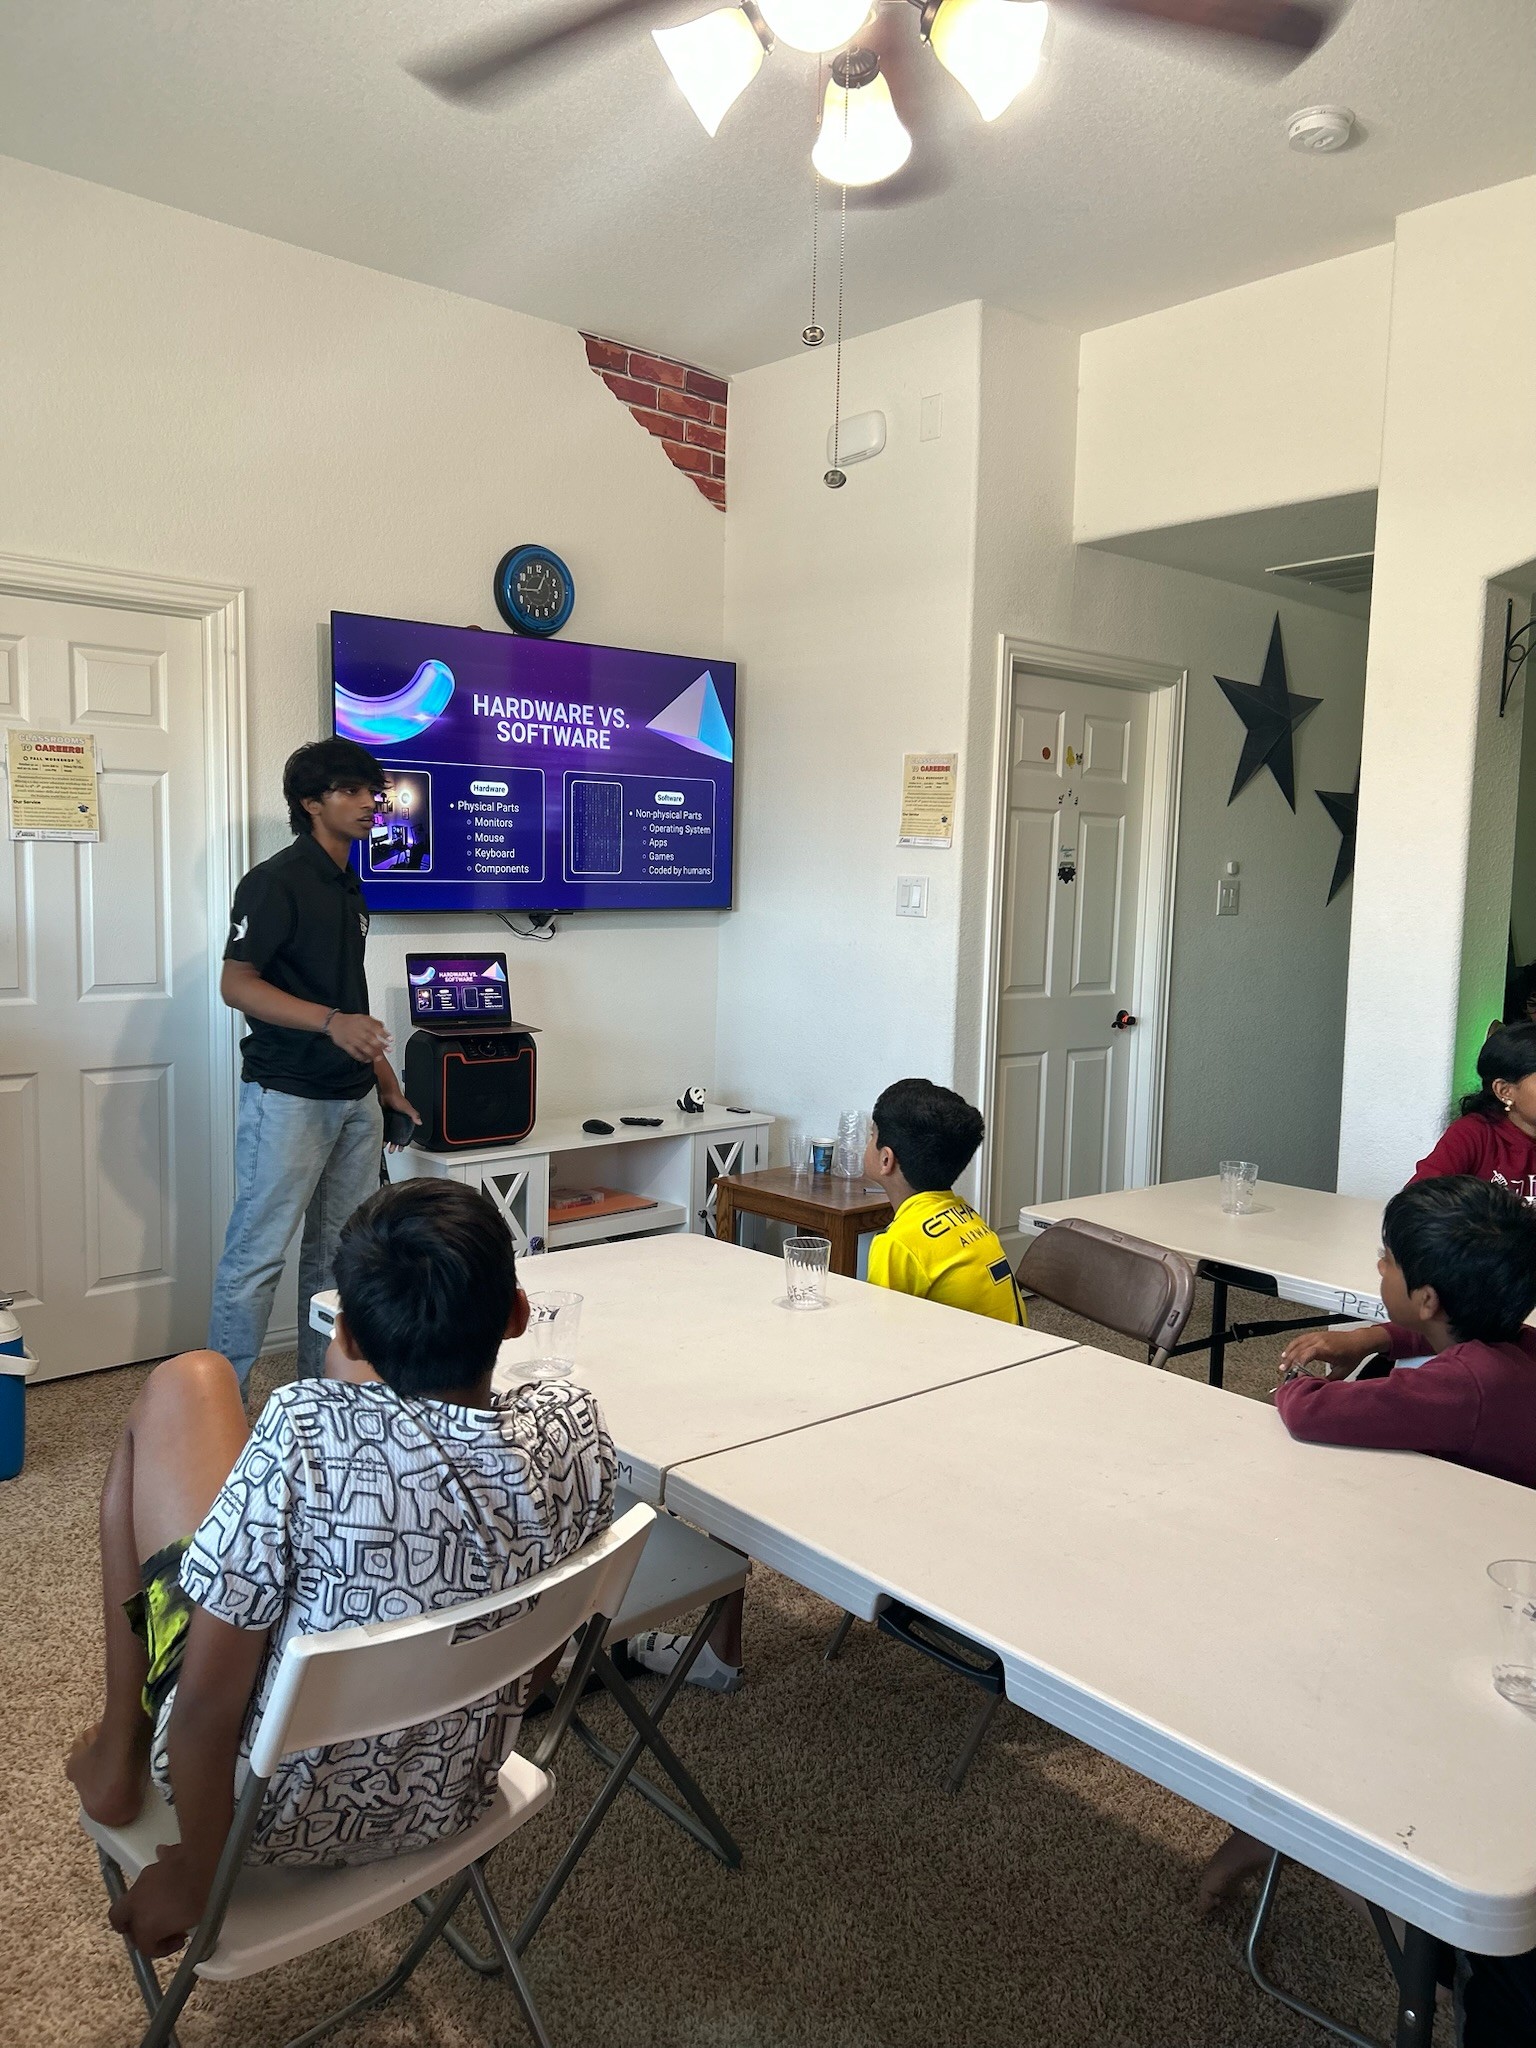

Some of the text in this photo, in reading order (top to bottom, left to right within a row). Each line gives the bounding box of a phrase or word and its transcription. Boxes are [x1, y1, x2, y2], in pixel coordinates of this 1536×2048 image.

[527, 566, 533, 574] 11
[536, 565, 542, 573] 12
[546, 570, 550, 578] 1
[552, 579, 556, 587] 2
[520, 595, 524, 604] 8
[554, 591, 559, 599] 3
[527, 605, 531, 613] 7
[535, 609, 539, 617] 6
[544, 608, 549, 616] 5
[473, 694, 630, 729] HARDWARE VS.
[19, 734, 85, 744] CLASSROOMS
[496, 720, 611, 750] SOFTWARE
[35, 744, 84, 754] CAREERS!
[473, 784, 506, 793] Hardware
[657, 794, 682, 802] Software
[457, 800, 520, 813] Physical Parts
[635, 809, 703, 821] Non-physical Parts
[474, 817, 513, 828] Monitors
[649, 823, 711, 836] Operating System
[474, 832, 505, 842] Mouse
[648, 838, 668, 848] Apps
[474, 848, 515, 860] Keyboard
[648, 851, 675, 861] Games
[475, 863, 530, 875] Components
[648, 865, 711, 876] Coded by humans
[1334, 1290, 1386, 1319] PER
